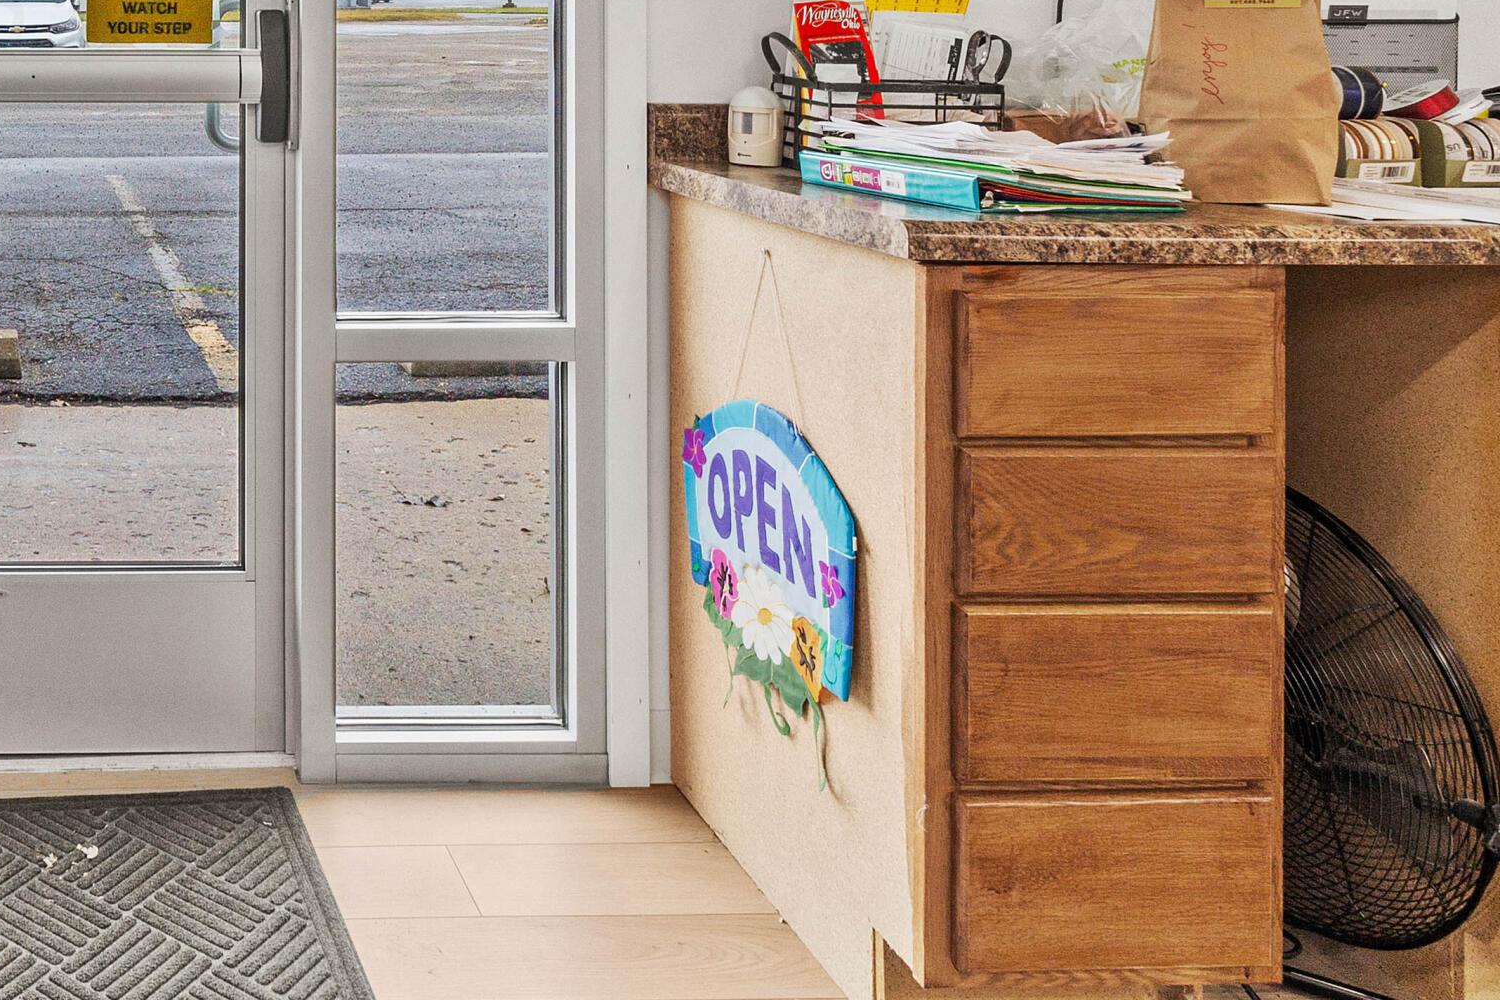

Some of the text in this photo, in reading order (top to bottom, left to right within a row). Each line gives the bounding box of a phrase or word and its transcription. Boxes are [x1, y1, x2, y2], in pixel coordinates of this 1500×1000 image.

[122, 1, 177, 15] WATCH
[797, 2, 858, 27] Waynesville
[107, 21, 192, 35] YOUR STEP
[841, 18, 860, 29] Ohio
[708, 449, 816, 599] OPEN
